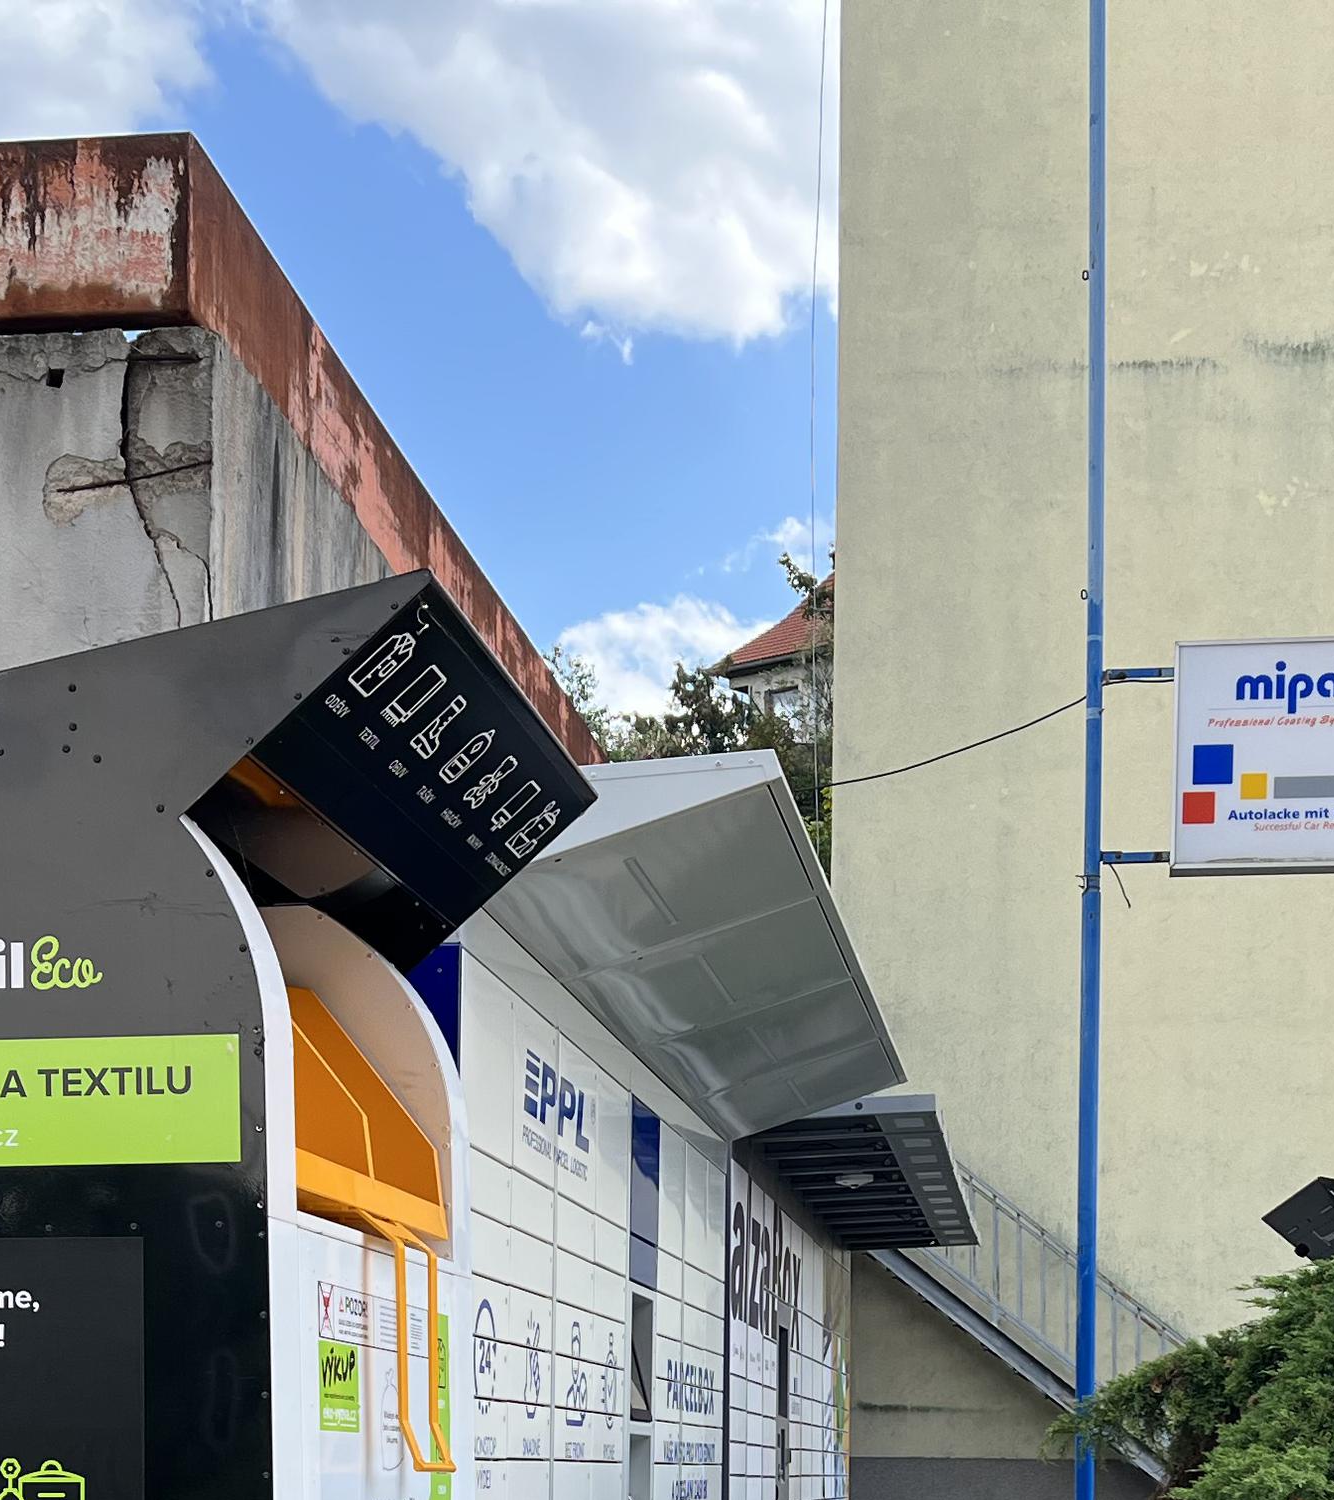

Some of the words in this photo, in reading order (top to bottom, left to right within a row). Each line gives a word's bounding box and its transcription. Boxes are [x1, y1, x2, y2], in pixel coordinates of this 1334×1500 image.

[325, 693, 351, 719] ODĚVY
[1208, 716, 1274, 728] Professional
[1277, 715, 1317, 728] Coating
[1228, 808, 1300, 821] Autolacke
[1305, 808, 1329, 819] mit
[1253, 821, 1302, 832] Successful
[1304, 821, 1320, 831] Car
[0, 1070, 28, 1099] A
[37, 1065, 193, 1098] TEXTILU
